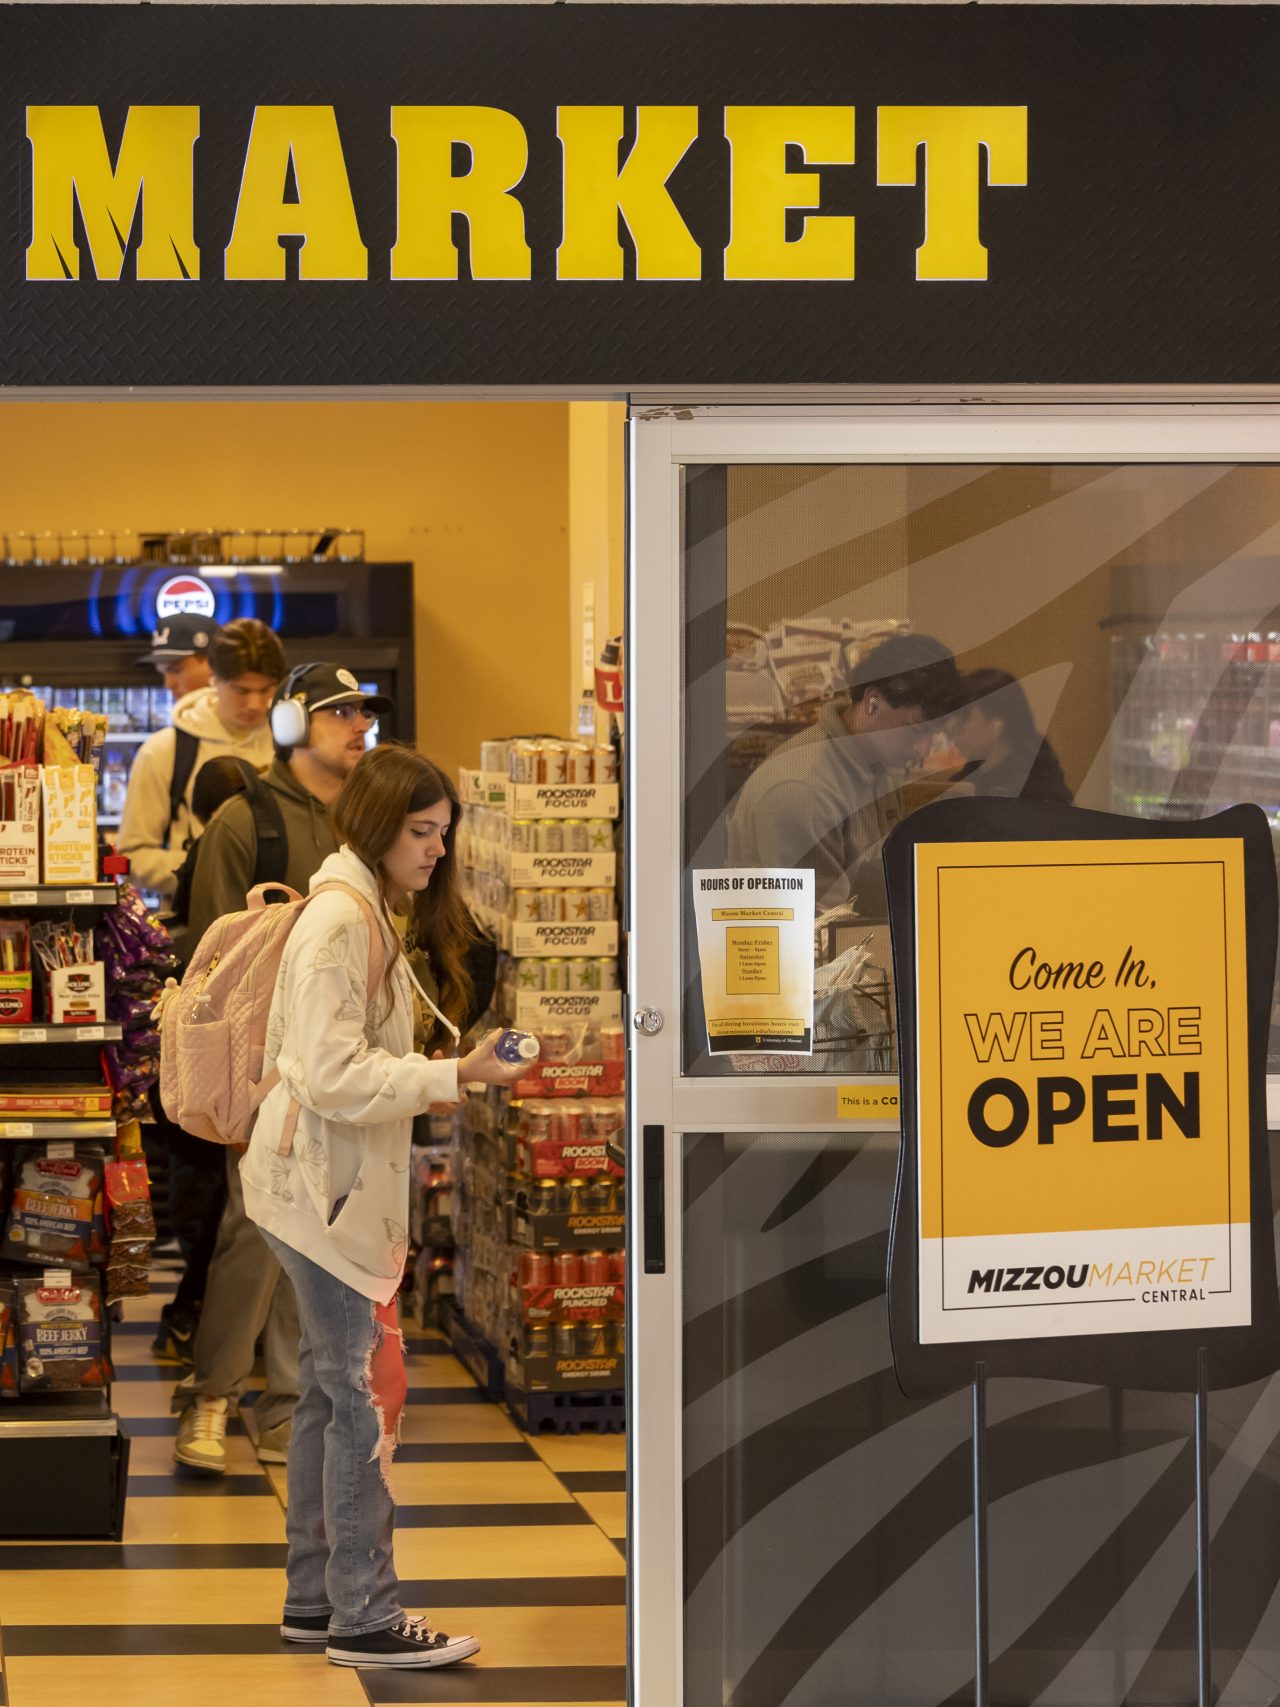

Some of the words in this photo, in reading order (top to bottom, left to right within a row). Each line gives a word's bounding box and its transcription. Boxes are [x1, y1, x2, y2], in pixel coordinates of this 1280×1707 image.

[25, 104, 1027, 282] MARKET
[163, 599, 209, 609] PEPSI
[536, 789, 596, 799] ROCKSTAR
[545, 800, 588, 808] FOCUS
[533, 858, 592, 868] ROCKSTAR
[541, 869, 584, 877] FOCUS
[700, 878, 730, 891] HOURS
[732, 878, 745, 890] OF
[747, 878, 804, 890] OPERATION
[536, 926, 596, 936] ROCKSTAR
[1009, 947, 1106, 990] Come
[1115, 945, 1157, 989] In,
[540, 996, 600, 1006] ROCKSTAR
[548, 1007, 591, 1015] FOCUS
[963, 1010, 1065, 1063] WE
[1080, 1006, 1202, 1059] ARE
[542, 1065, 603, 1078] ROCKSTAR
[841, 1097, 860, 1105] This
[863, 1097, 870, 1105] is
[967, 1071, 1201, 1148] OPEN
[562, 1146, 606, 1158] ROCKST
[568, 1215, 625, 1228] ROCKSTAR
[554, 1286, 616, 1299] ROCKSTAR
[1141, 1288, 1206, 1303] CENTRAL
[562, 1298, 608, 1308] PUNCHED
[36, 1328, 60, 1342] BEEF
[61, 1327, 88, 1341] JERKY
[556, 1358, 618, 1371] ROCKSTAR
